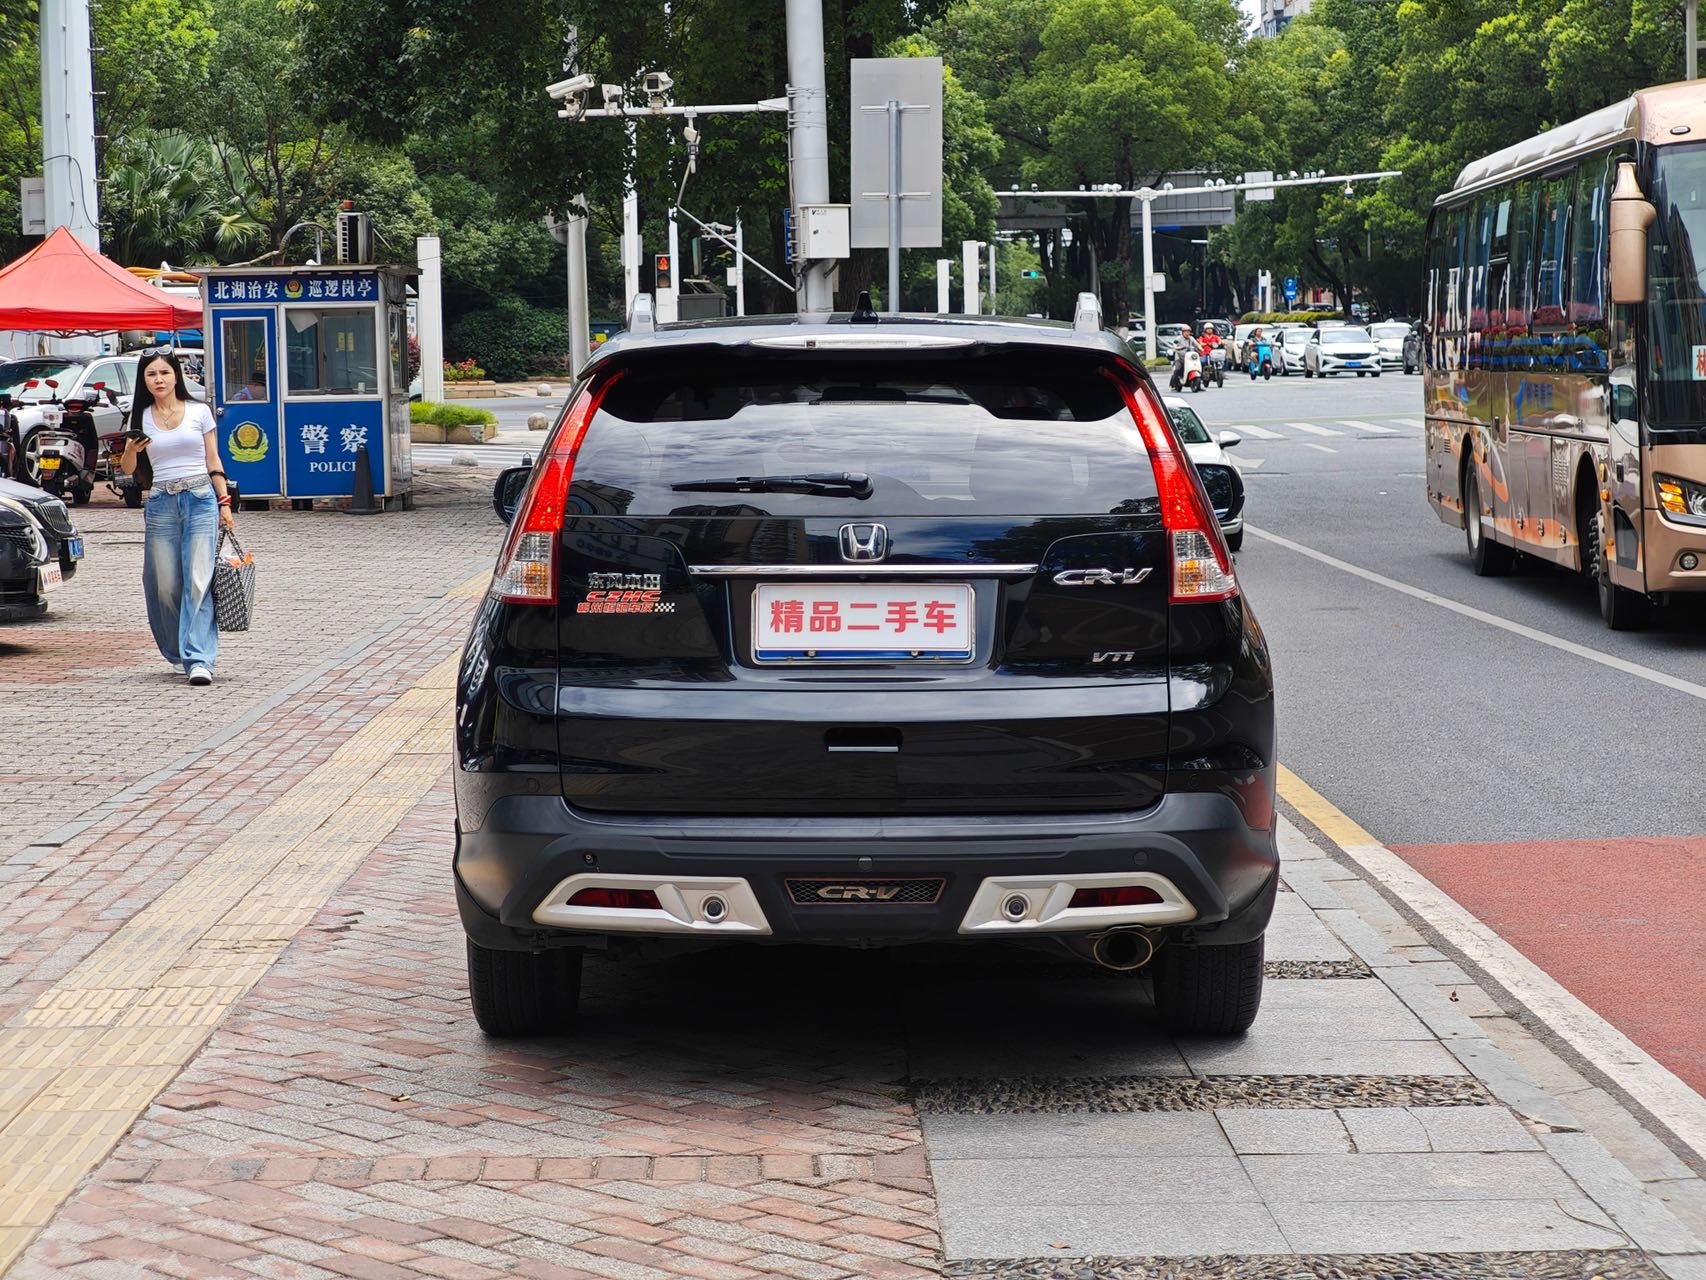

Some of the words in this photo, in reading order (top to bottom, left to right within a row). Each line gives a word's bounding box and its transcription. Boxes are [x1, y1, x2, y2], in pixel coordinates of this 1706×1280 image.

[214, 280, 279, 300] 北湖治安
[308, 278, 372, 298] 巡逻岗亭
[299, 423, 369, 455] 警察
[587, 572, 662, 590] 东风本田
[1053, 567, 1154, 586] CR-V
[586, 590, 663, 602] CZHC
[770, 600, 957, 634] 精品二手车
[816, 885, 902, 900] CR-V
